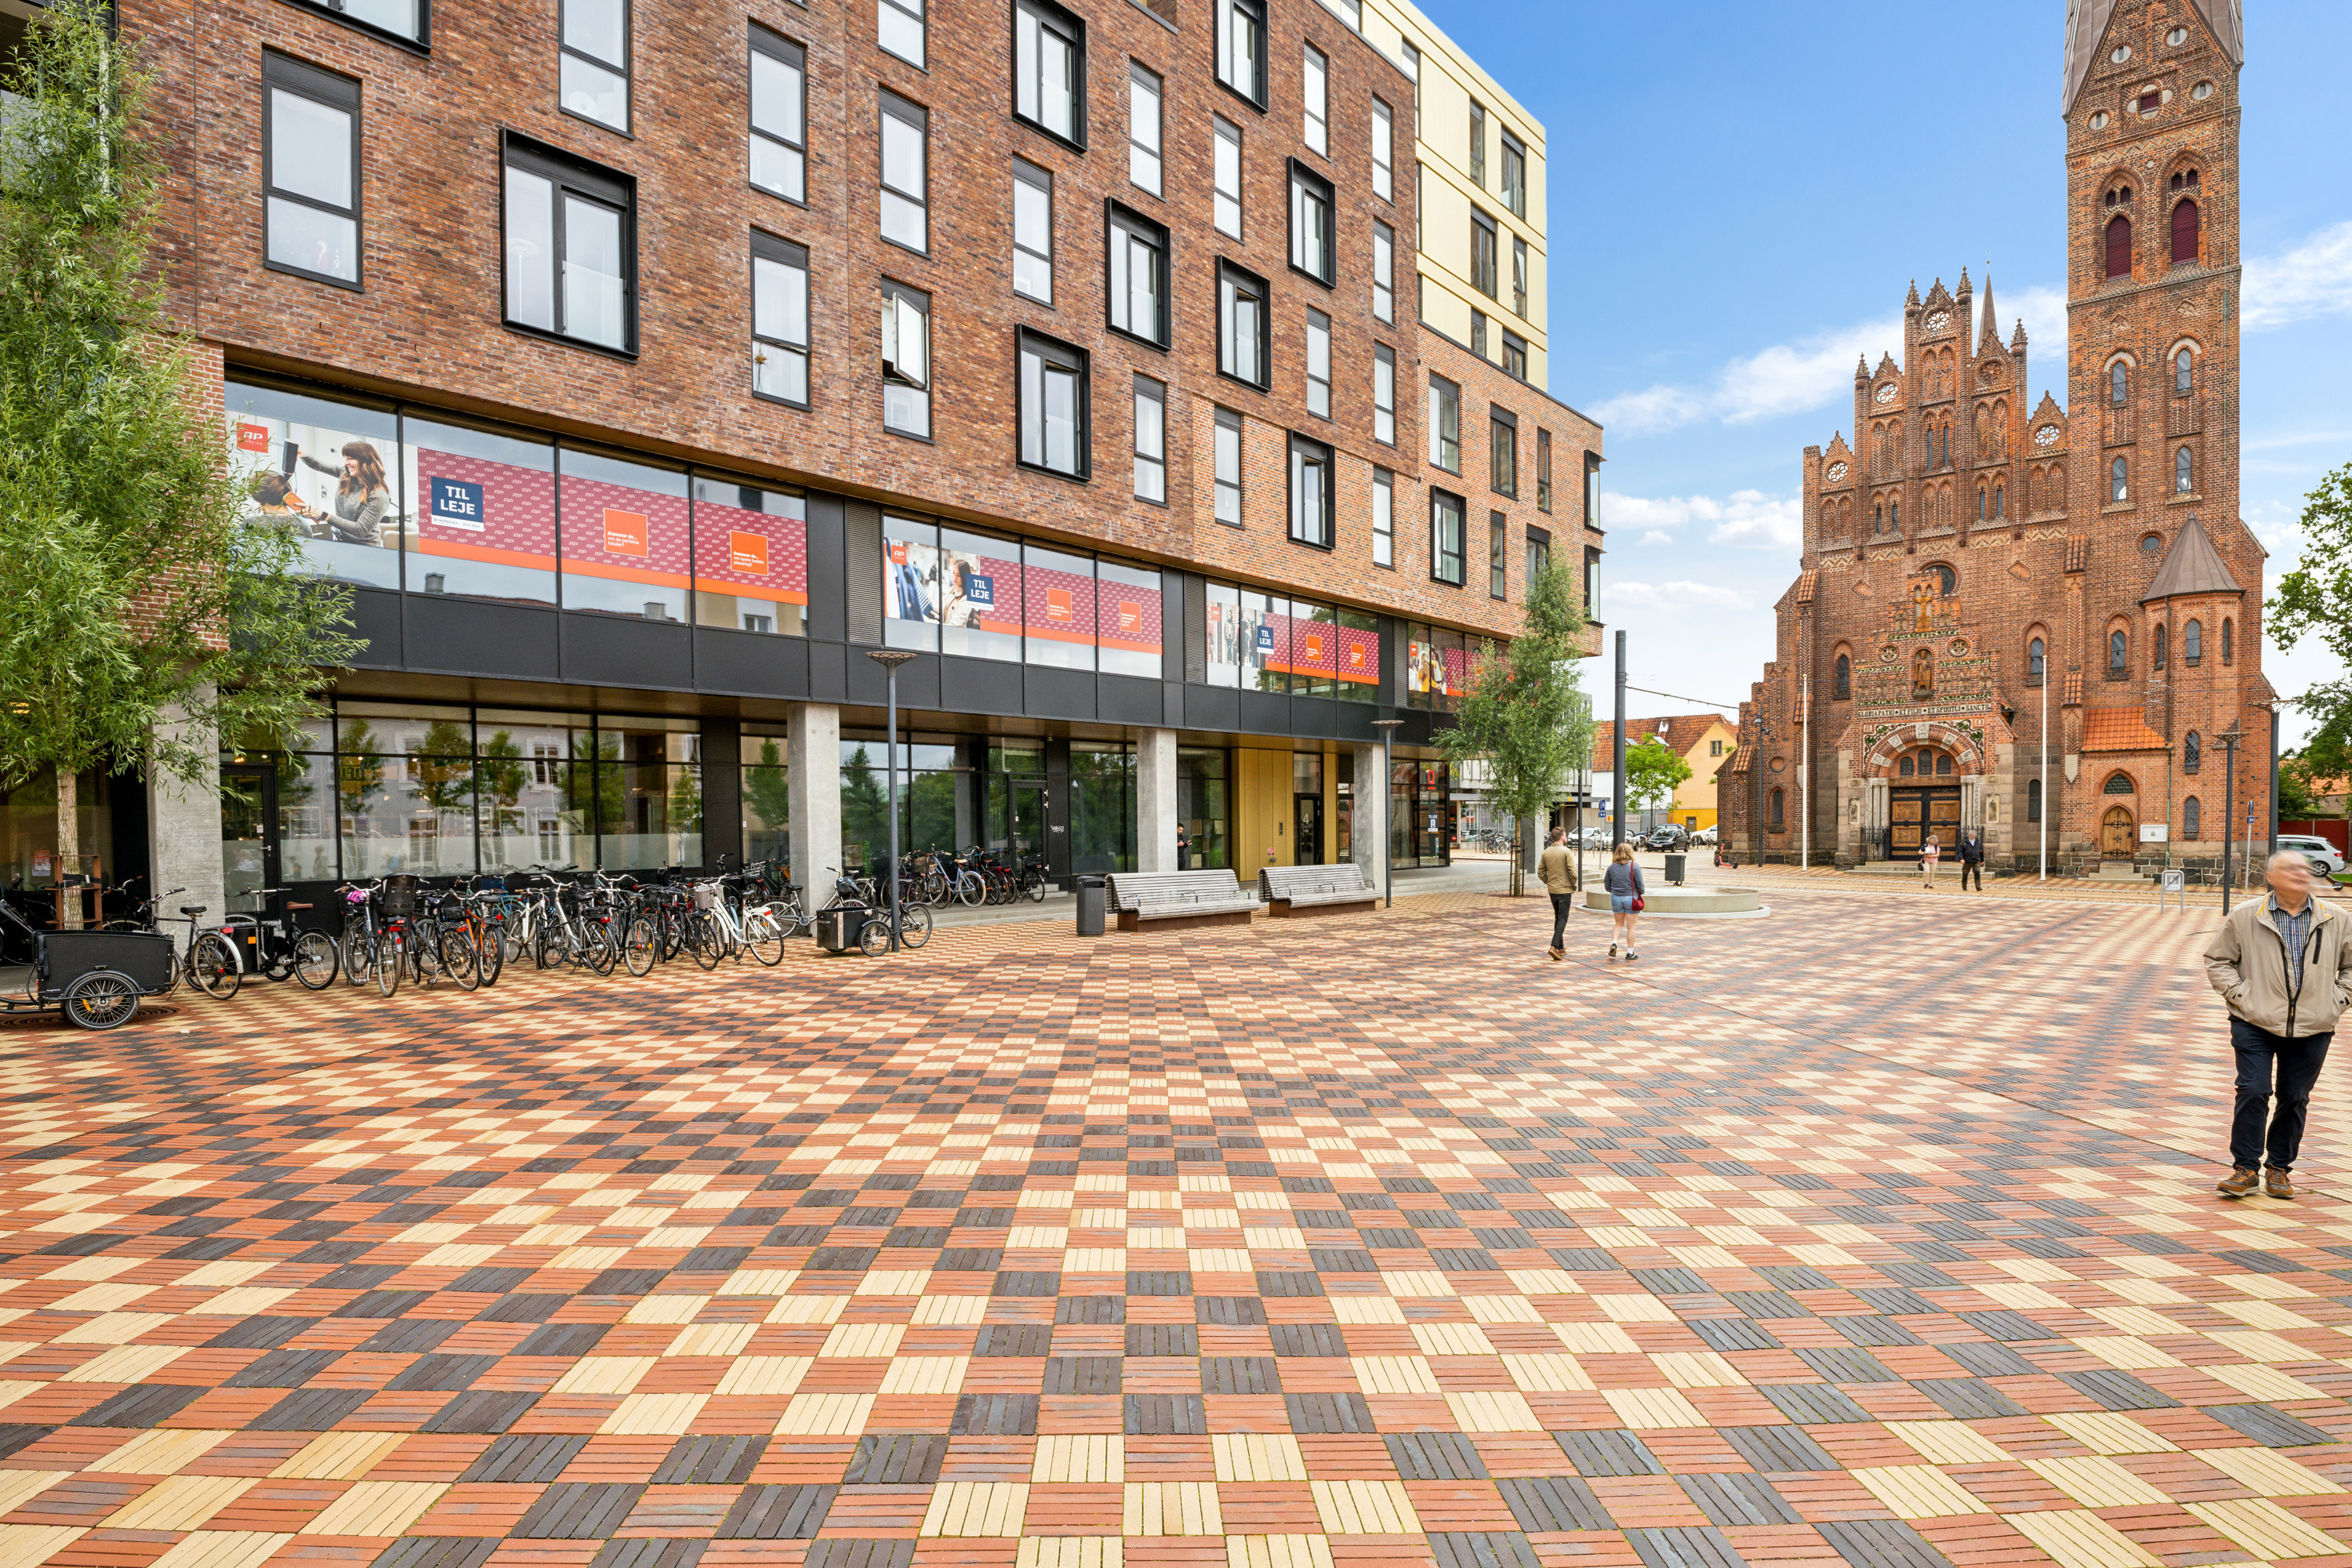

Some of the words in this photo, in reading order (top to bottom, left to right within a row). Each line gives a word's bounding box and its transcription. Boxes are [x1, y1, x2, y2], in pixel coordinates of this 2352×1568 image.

[243, 431, 263, 441] AP
[445, 485, 470, 500] TIL
[440, 499, 475, 515] LEJE
[973, 579, 986, 590] TIL
[971, 589, 989, 600] LEJE
[1259, 637, 1272, 646] LEJE
[1303, 814, 1309, 825] 4
